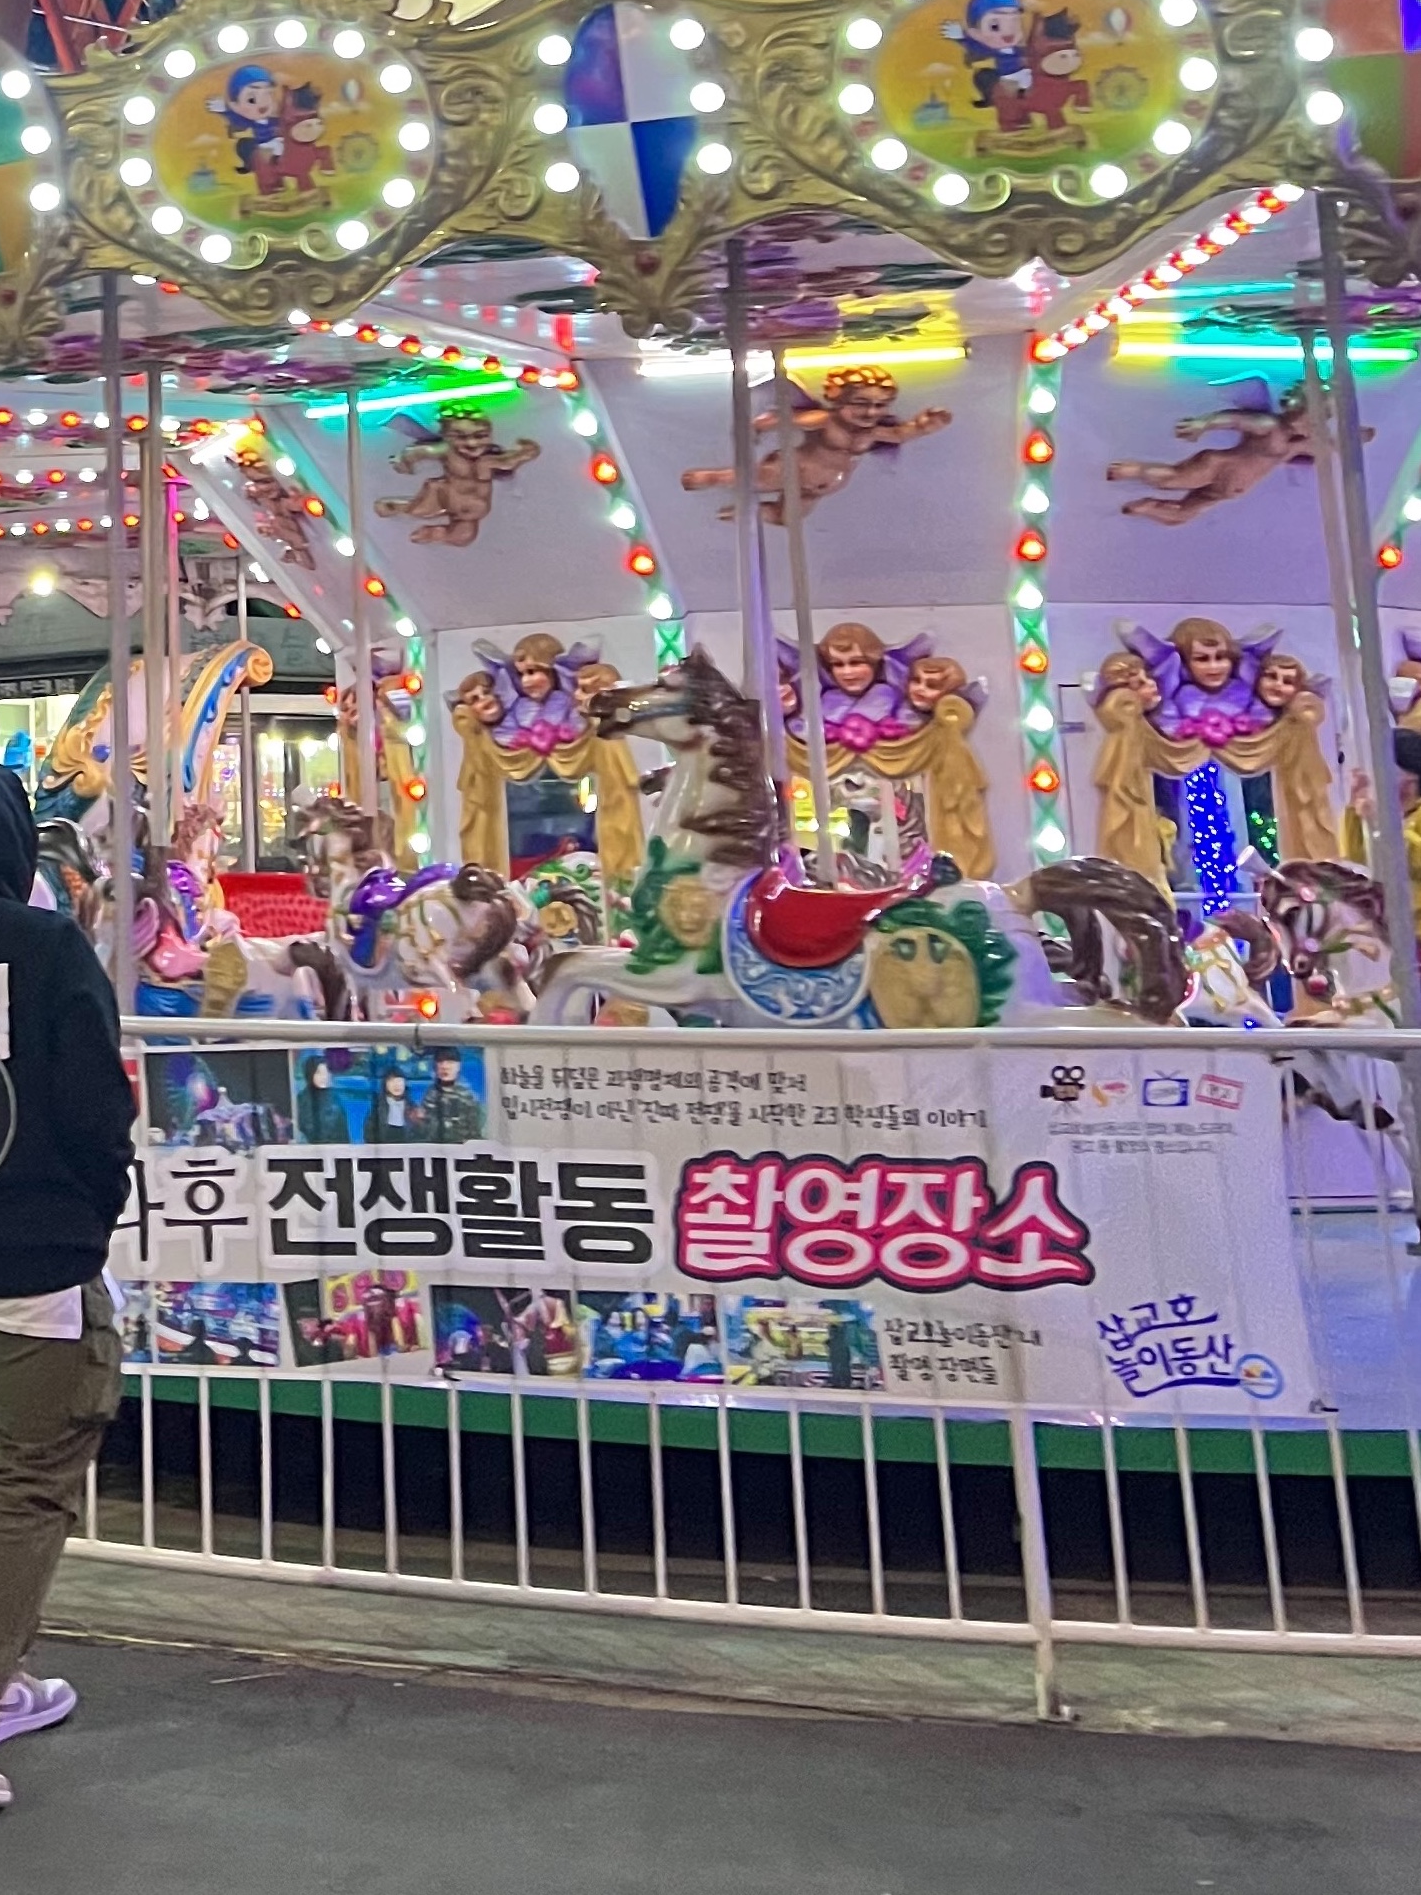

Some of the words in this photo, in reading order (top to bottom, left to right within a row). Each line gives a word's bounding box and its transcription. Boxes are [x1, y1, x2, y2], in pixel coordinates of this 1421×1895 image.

[500, 1064, 545, 1091] 하늘을
[927, 1108, 988, 1129] 이야기
[163, 1158, 250, 1264] 후
[267, 1152, 655, 1265] 전쟁활동
[680, 1160, 1087, 1282] 촬영장소
[1096, 1293, 1220, 1352] 삽교호
[1105, 1333, 1240, 1398] 놀이동산
